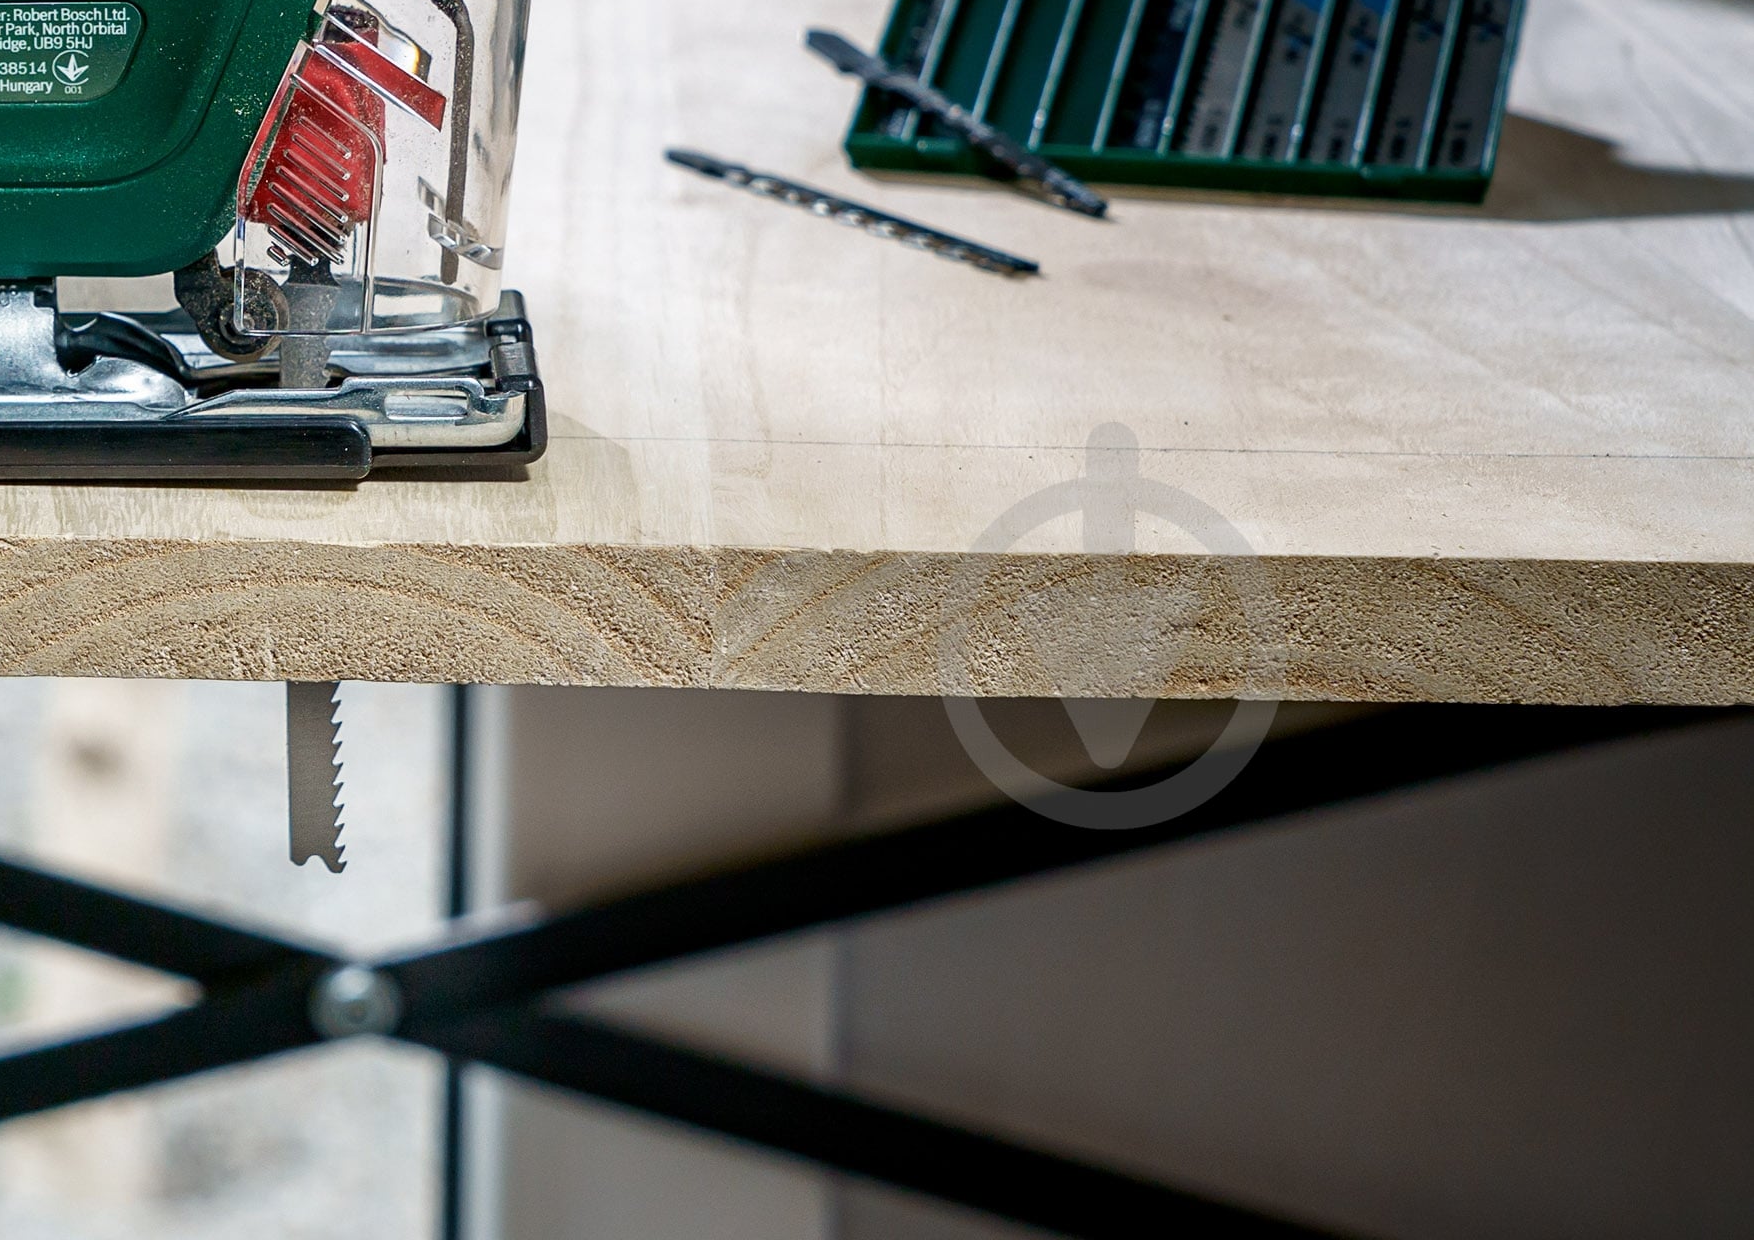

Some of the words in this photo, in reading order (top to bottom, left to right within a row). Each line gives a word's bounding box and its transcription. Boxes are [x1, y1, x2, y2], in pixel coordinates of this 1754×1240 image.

[13, 8, 59, 22] Robert
[61, 8, 102, 21] Bosch
[104, 7, 131, 21] Ltd.
[5, 23, 40, 37] Park,
[42, 22, 79, 35] North
[82, 21, 127, 35] Orbital
[34, 36, 63, 50] UB9
[66, 36, 93, 50] 5HJ
[0, 80, 53, 95] Hungary
[64, 85, 83, 94] 001
